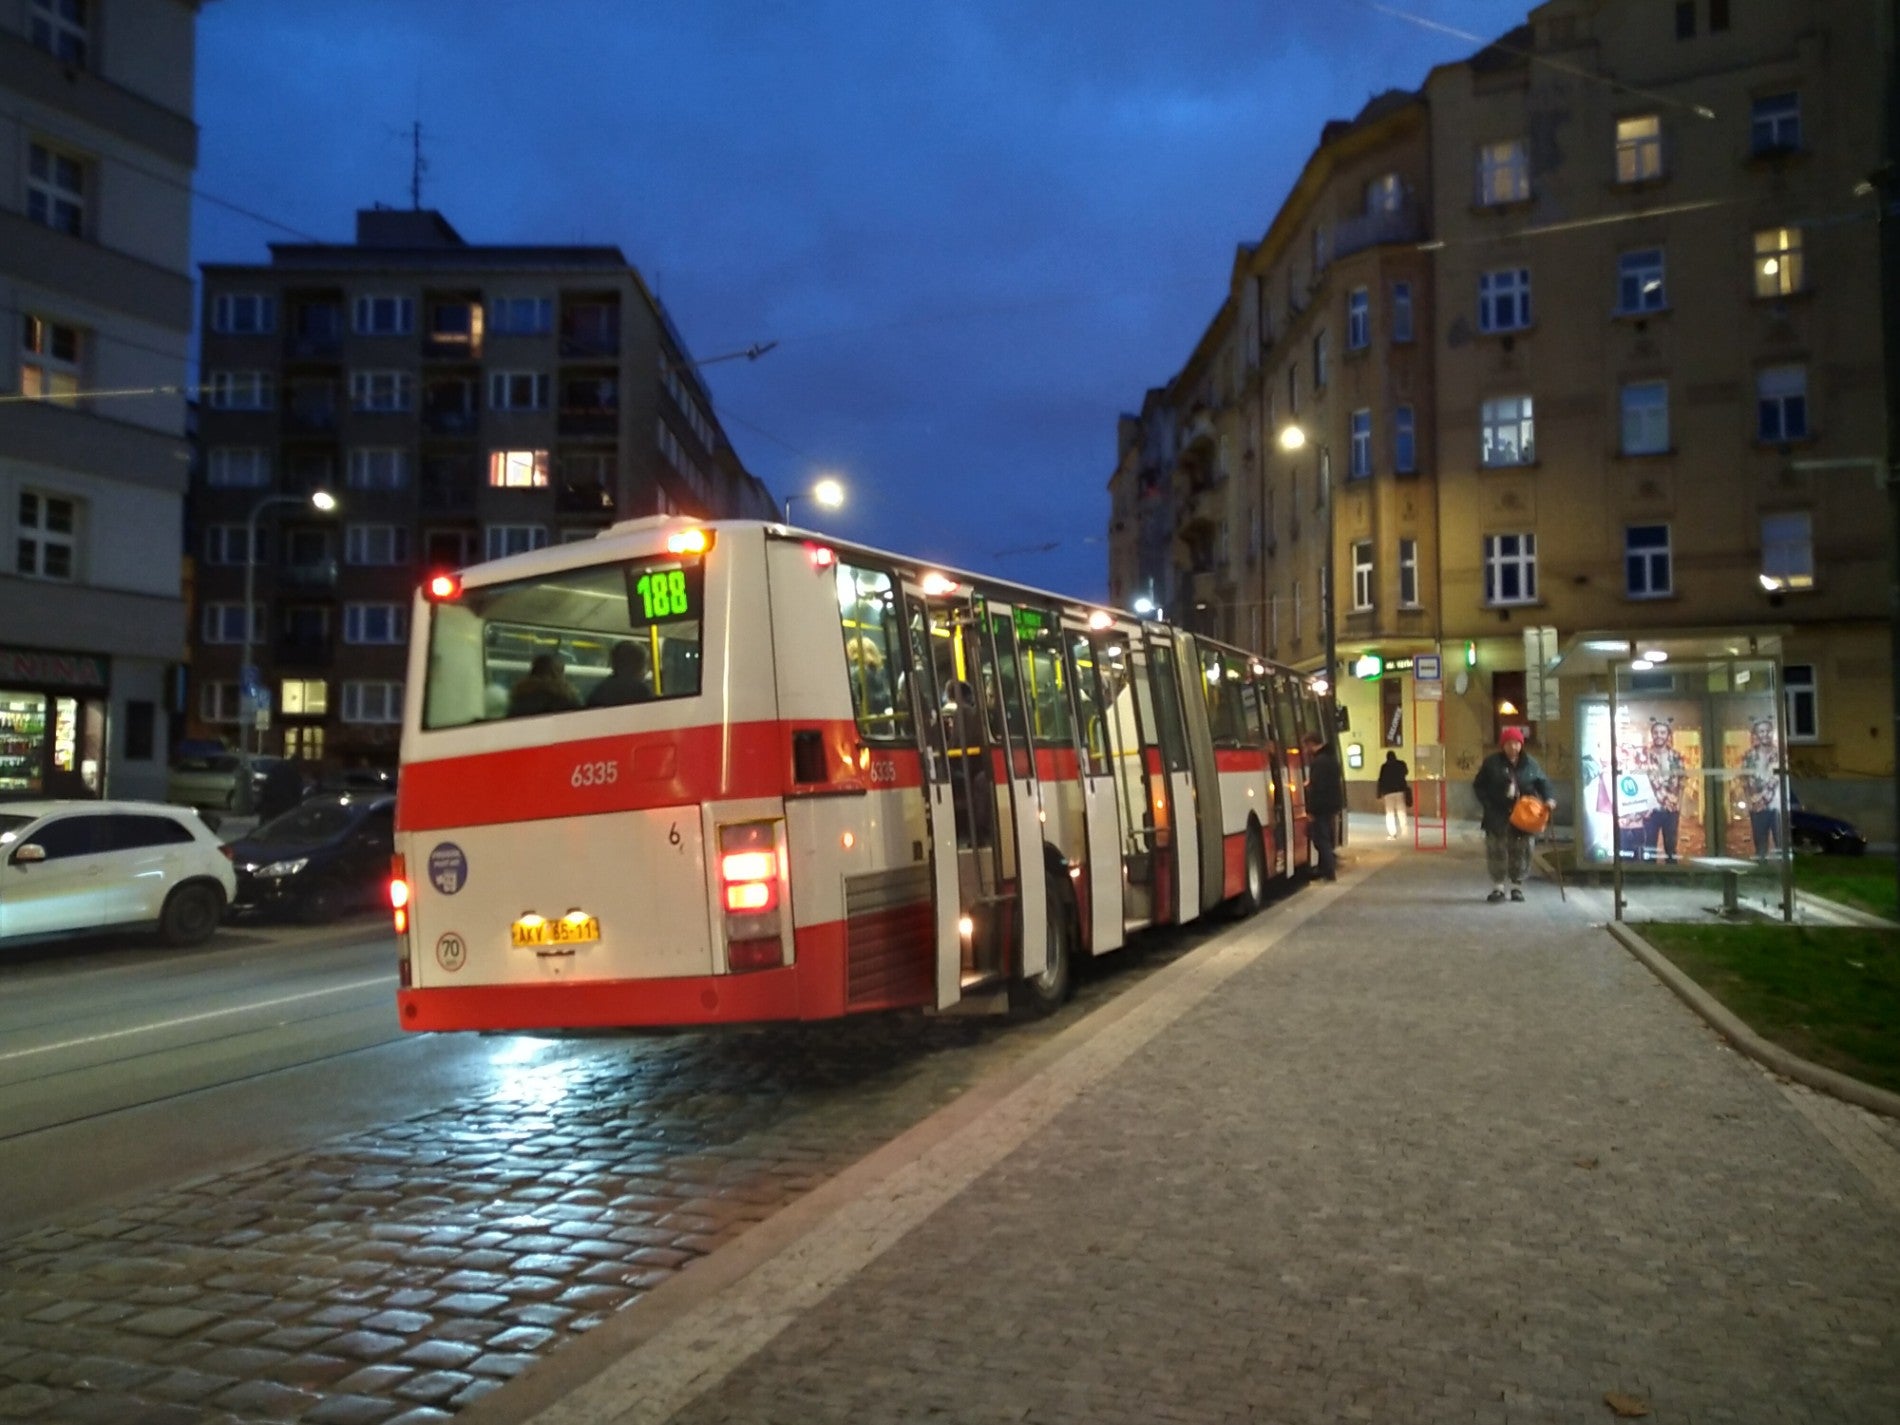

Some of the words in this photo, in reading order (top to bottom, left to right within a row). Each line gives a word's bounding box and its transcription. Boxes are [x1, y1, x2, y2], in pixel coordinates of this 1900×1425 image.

[637, 571, 688, 619] 188
[571, 761, 618, 788] 6335
[441, 939, 460, 958] 70
